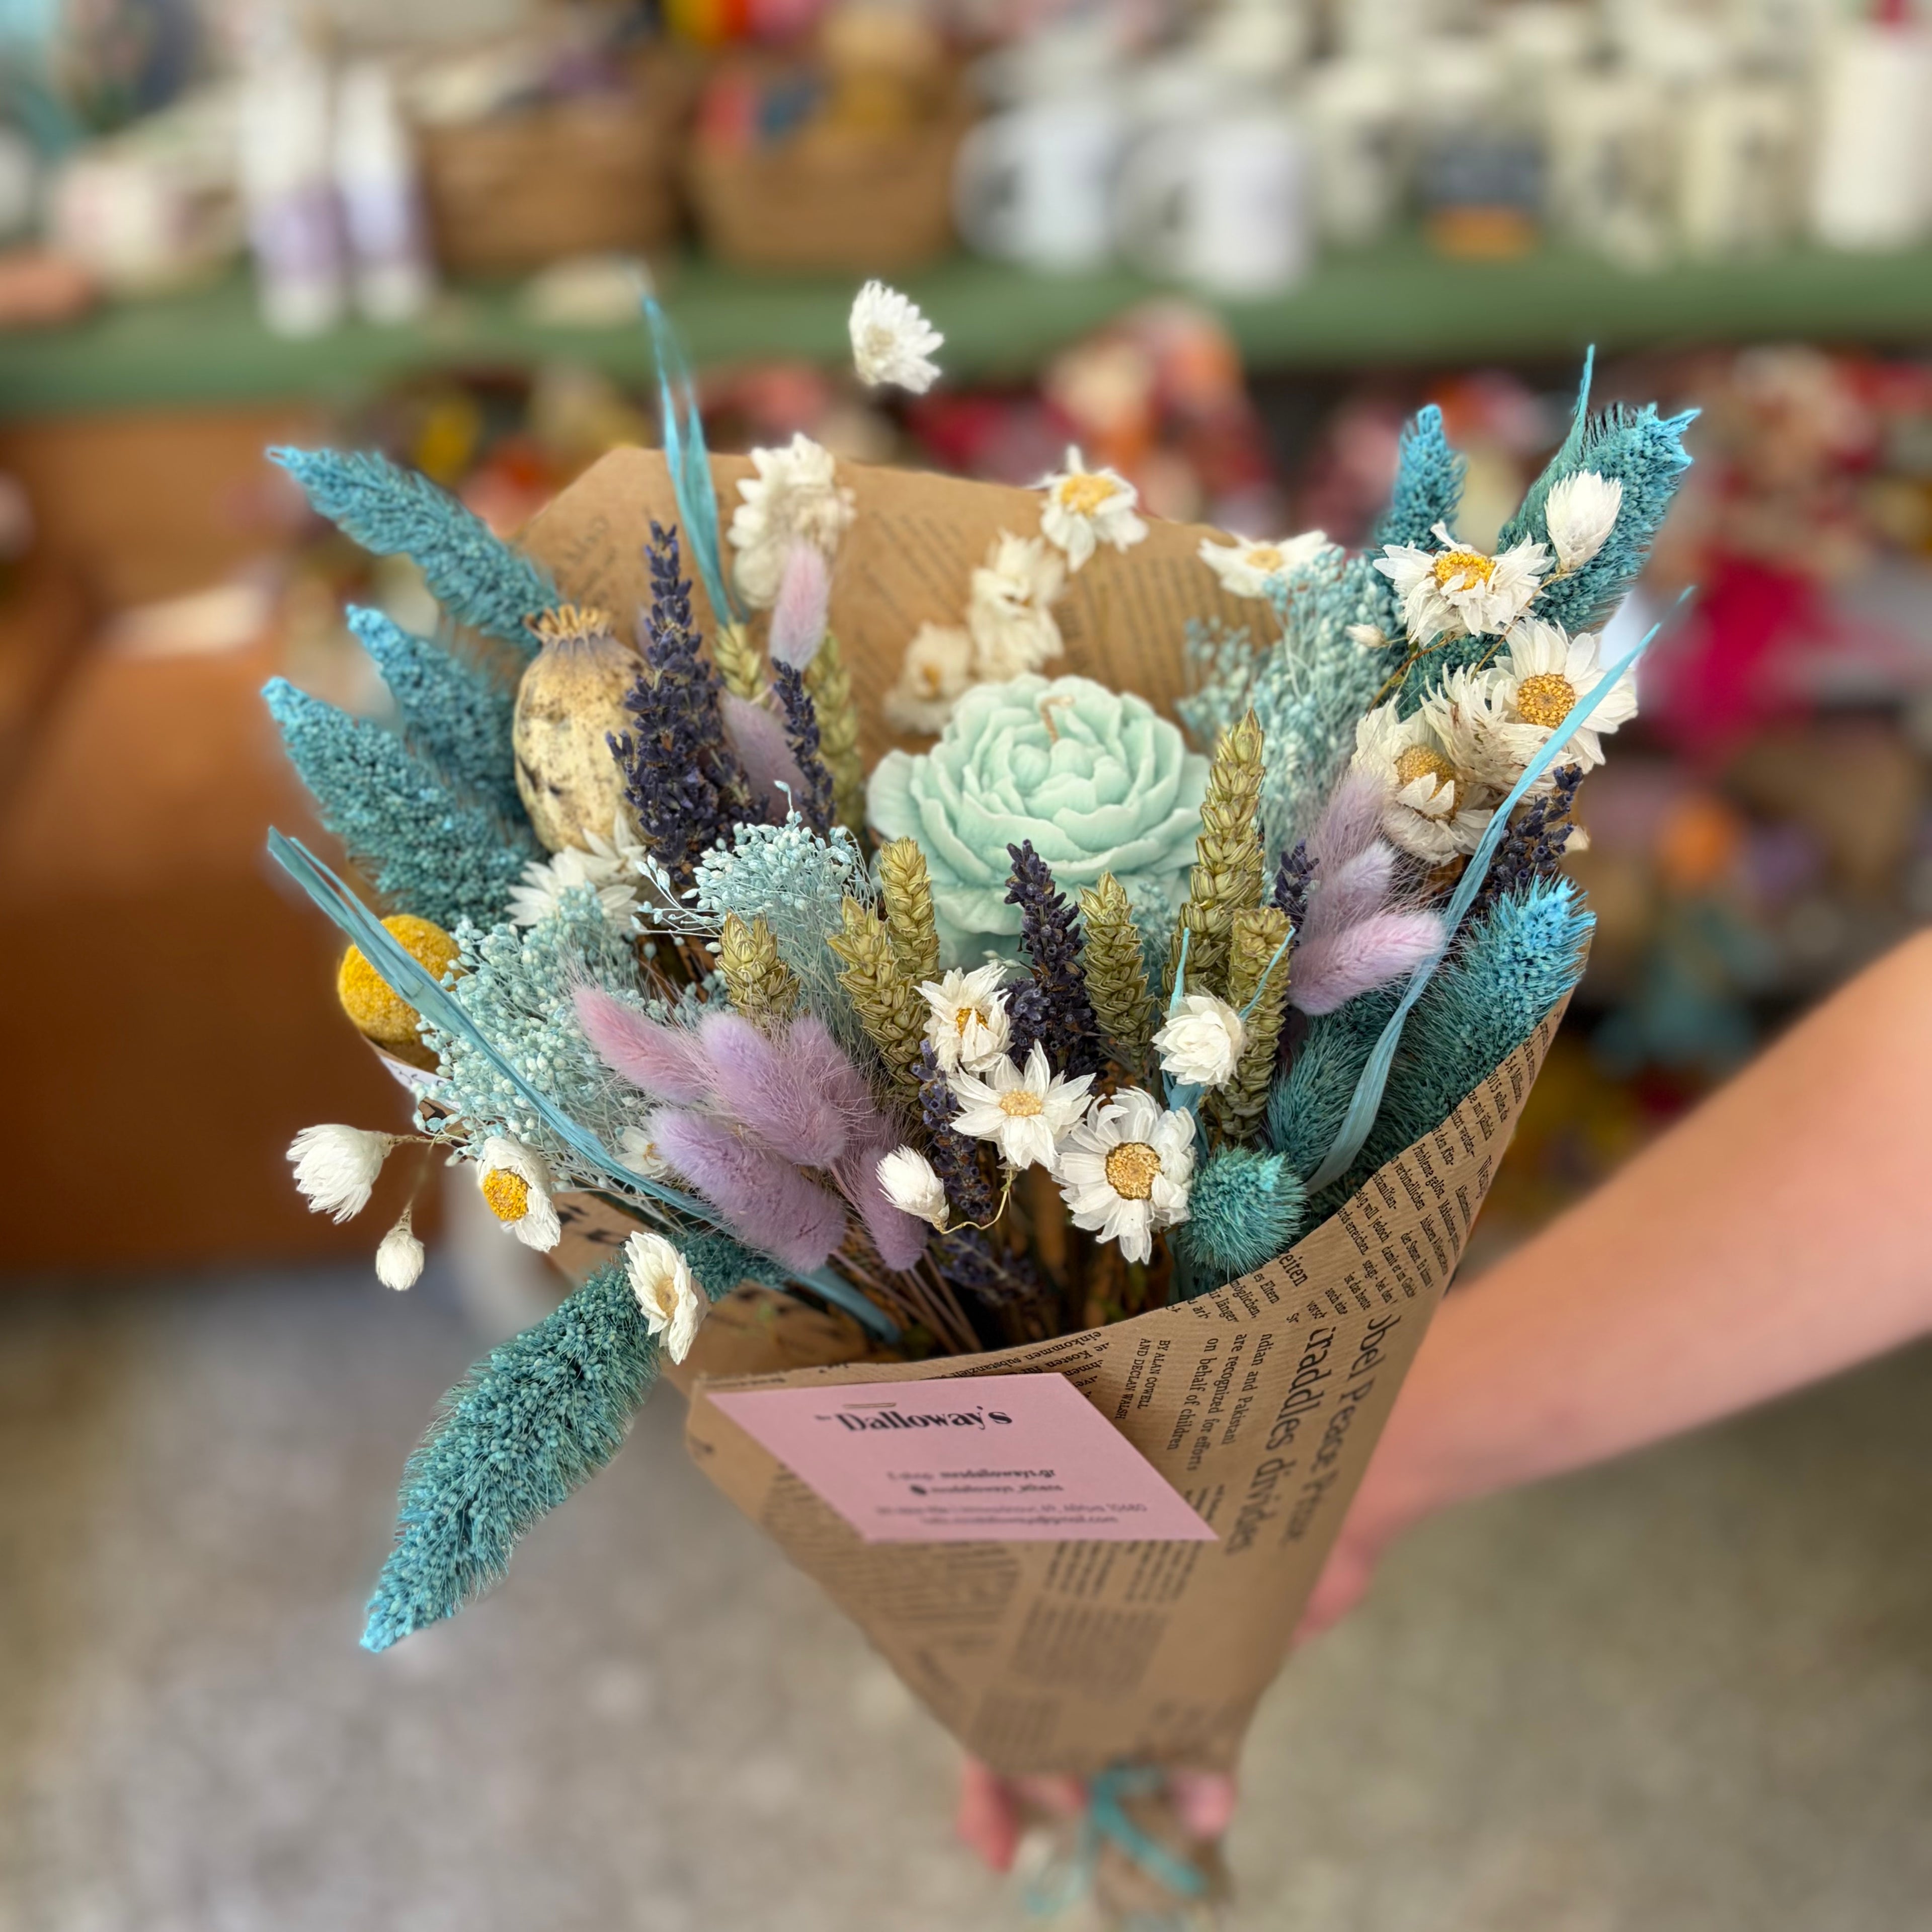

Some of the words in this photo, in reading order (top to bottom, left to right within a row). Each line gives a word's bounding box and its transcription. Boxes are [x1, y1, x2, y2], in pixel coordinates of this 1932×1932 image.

[1484, 1069, 1502, 1093] 2015
[1473, 1102, 1487, 1118] mit
[1434, 1132, 1448, 1150] dem
[1412, 1143, 1434, 1178] Probleme
[1425, 1176, 1445, 1200] gelöst.
[1394, 1162, 1425, 1211] verbindlichen
[1362, 1202, 1380, 1220] will
[1345, 1221, 1370, 1256] erreichen.
[1367, 1216, 1393, 1243] jedoch
[1400, 1230, 1413, 1245] der
[1362, 1259, 1379, 1279] steigt
[1381, 1244, 1400, 1267] damit
[1392, 1264, 1402, 1273] er
[1253, 1272, 1265, 1283] es
[1260, 1279, 1280, 1304] Eltern
[1343, 1271, 1356, 1285] ist
[1349, 1280, 1361, 1295] das
[1375, 1276, 1390, 1293] bei
[1325, 1287, 1342, 1305] auch
[1355, 1288, 1372, 1311] heute
[1381, 1287, 1394, 1304] den
[1023, 1331, 1102, 1361] einkommen
[1137, 1337, 1152, 1357] AND
[1159, 1339, 1171, 1352] BY
[1203, 1338, 1219, 1353] on
[1231, 1333, 1247, 1353] are
[1251, 1333, 1274, 1366] ndian
[1044, 1350, 1093, 1369] Kosten
[1149, 1352, 1166, 1375] ALAN
[1125, 1359, 1145, 1392] DECLAN
[1189, 1357, 1218, 1392] behalf
[1208, 1355, 1239, 1414] recognized
[1242, 1371, 1258, 1392] and
[1137, 1376, 1157, 1410] COWELL
[1184, 1394, 1200, 1406] of
[1115, 1392, 1134, 1420] WALSH
[834, 1405, 1013, 1432] Dalloway's
[1167, 1408, 1196, 1451] children
[1200, 1418, 1220, 1433] for
[1221, 1395, 1254, 1445] Pakistani
[1186, 1435, 1212, 1471] efforts
